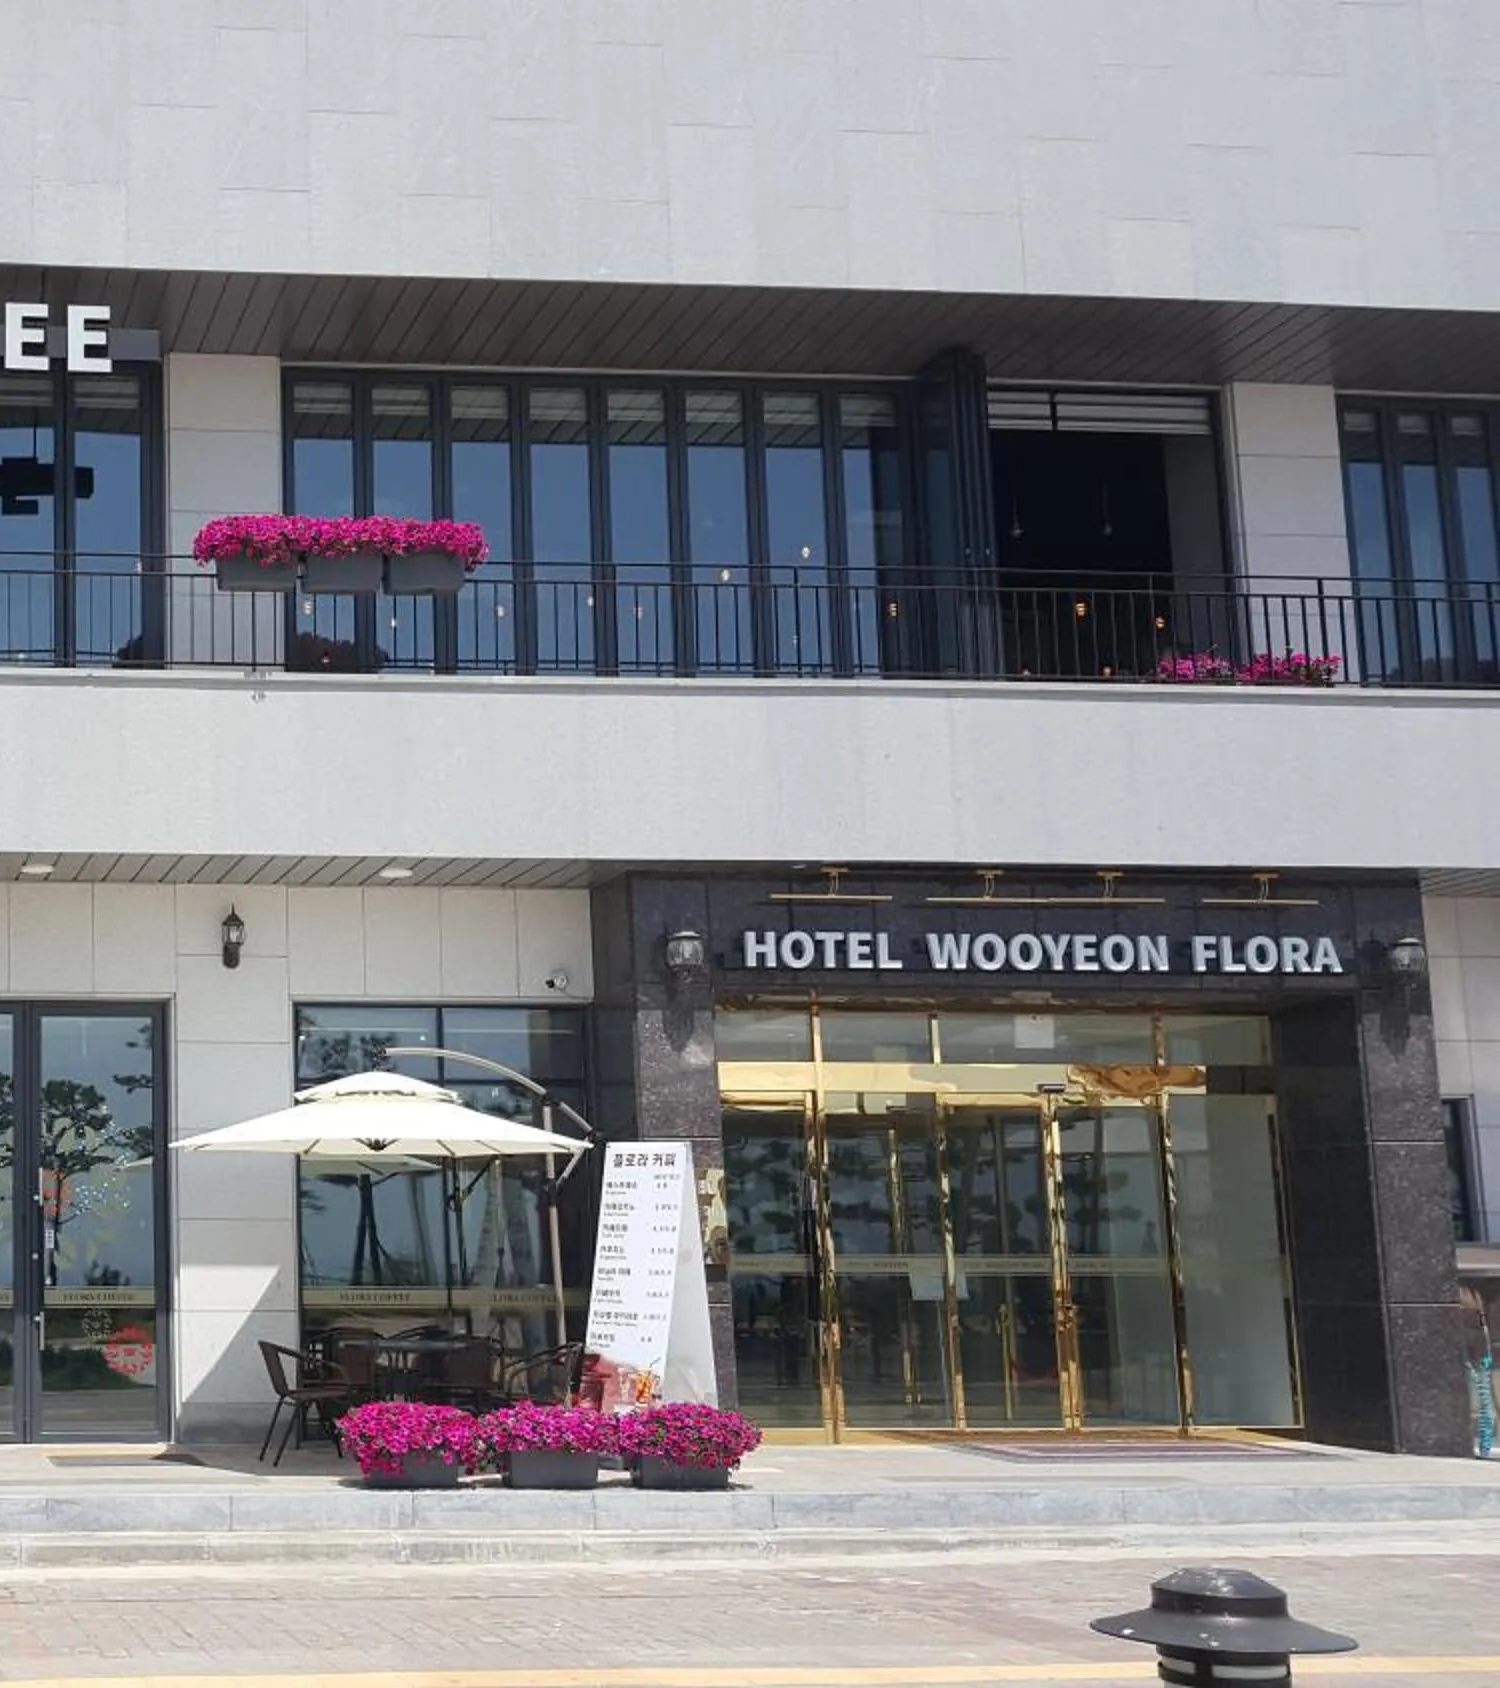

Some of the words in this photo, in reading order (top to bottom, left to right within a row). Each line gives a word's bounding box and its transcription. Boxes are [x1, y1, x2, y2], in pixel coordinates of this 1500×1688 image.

[743, 931, 903, 969] HOTEL
[926, 933, 1169, 972] WOOYEON
[1192, 935, 1343, 973] FLORA
[652, 1152, 677, 1167] 커피
